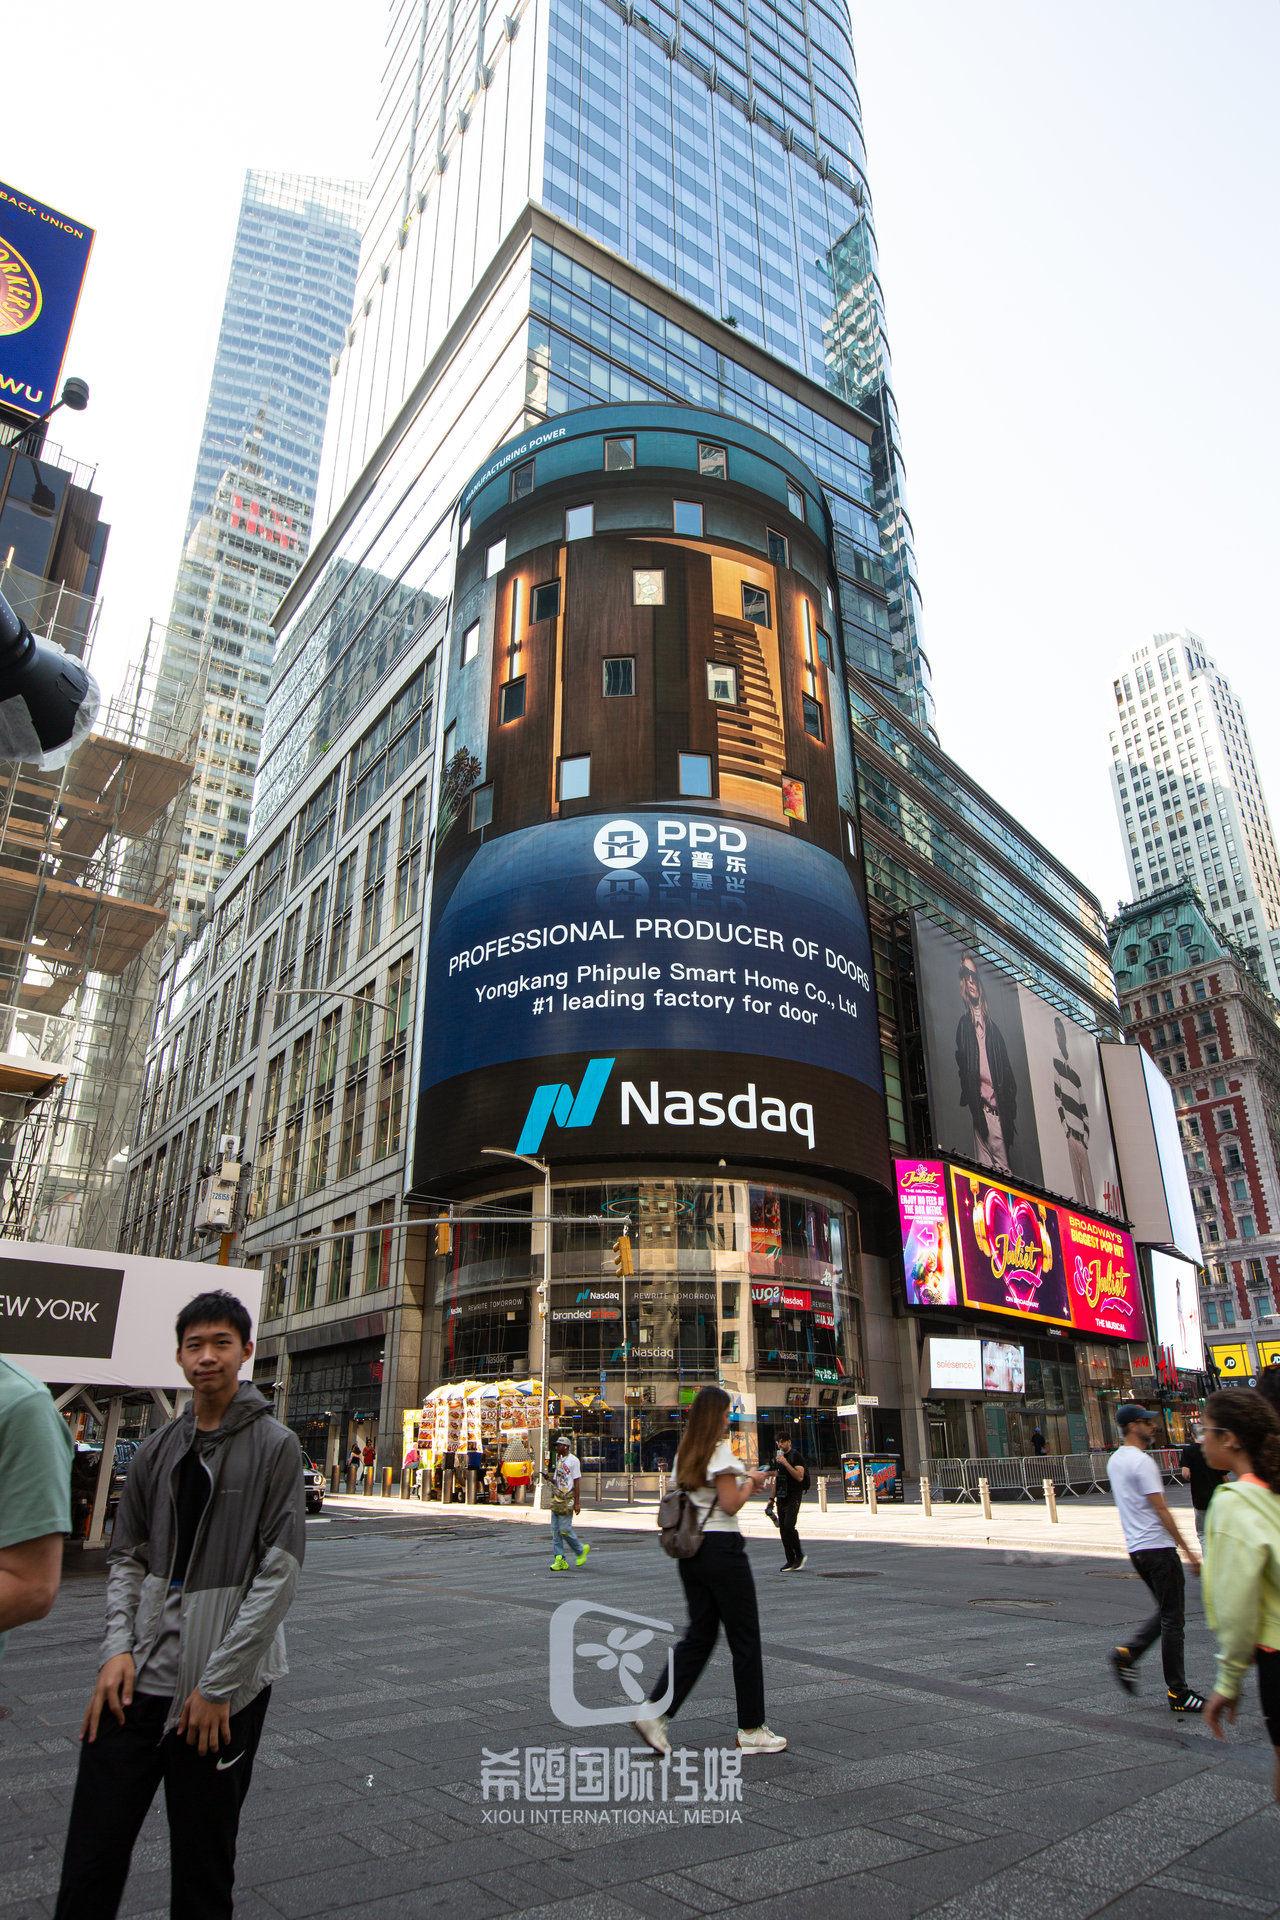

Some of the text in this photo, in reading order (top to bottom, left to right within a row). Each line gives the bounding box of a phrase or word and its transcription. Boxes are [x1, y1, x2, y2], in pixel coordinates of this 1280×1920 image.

[0, 190, 84, 239] BACK UNION
[465, 427, 566, 504] MANUFACTURING POWER
[658, 820, 747, 853] PPD
[658, 849, 747, 875] 飞普乐
[448, 918, 870, 992] PROFESSIONAL PRODUCER OF DOORS
[475, 962, 858, 1019] Yongkang Phipule Smart Home Co., Ltd
[532, 988, 819, 1026] #1 leading factory for door
[620, 1080, 816, 1150] Nasdaq
[1069, 1216, 1122, 1244] BROADWAY'S
[1071, 1230, 1124, 1258] BIGGEST POP HIT
[991, 1234, 1042, 1278] Juliet
[590, 1291, 717, 1301] Nasdaq REWRITE TOMORROW
[1086, 1259, 1131, 1309] Juliet
[35, 1297, 100, 1323] YORK
[552, 1308, 619, 1321] brandedcities
[780, 1296, 804, 1307] Nasdaq
[1095, 1318, 1127, 1332] THE MUSICAL
[631, 1347, 674, 1360] Nasdaq
[1225, 1359, 1236, 1367] JD
